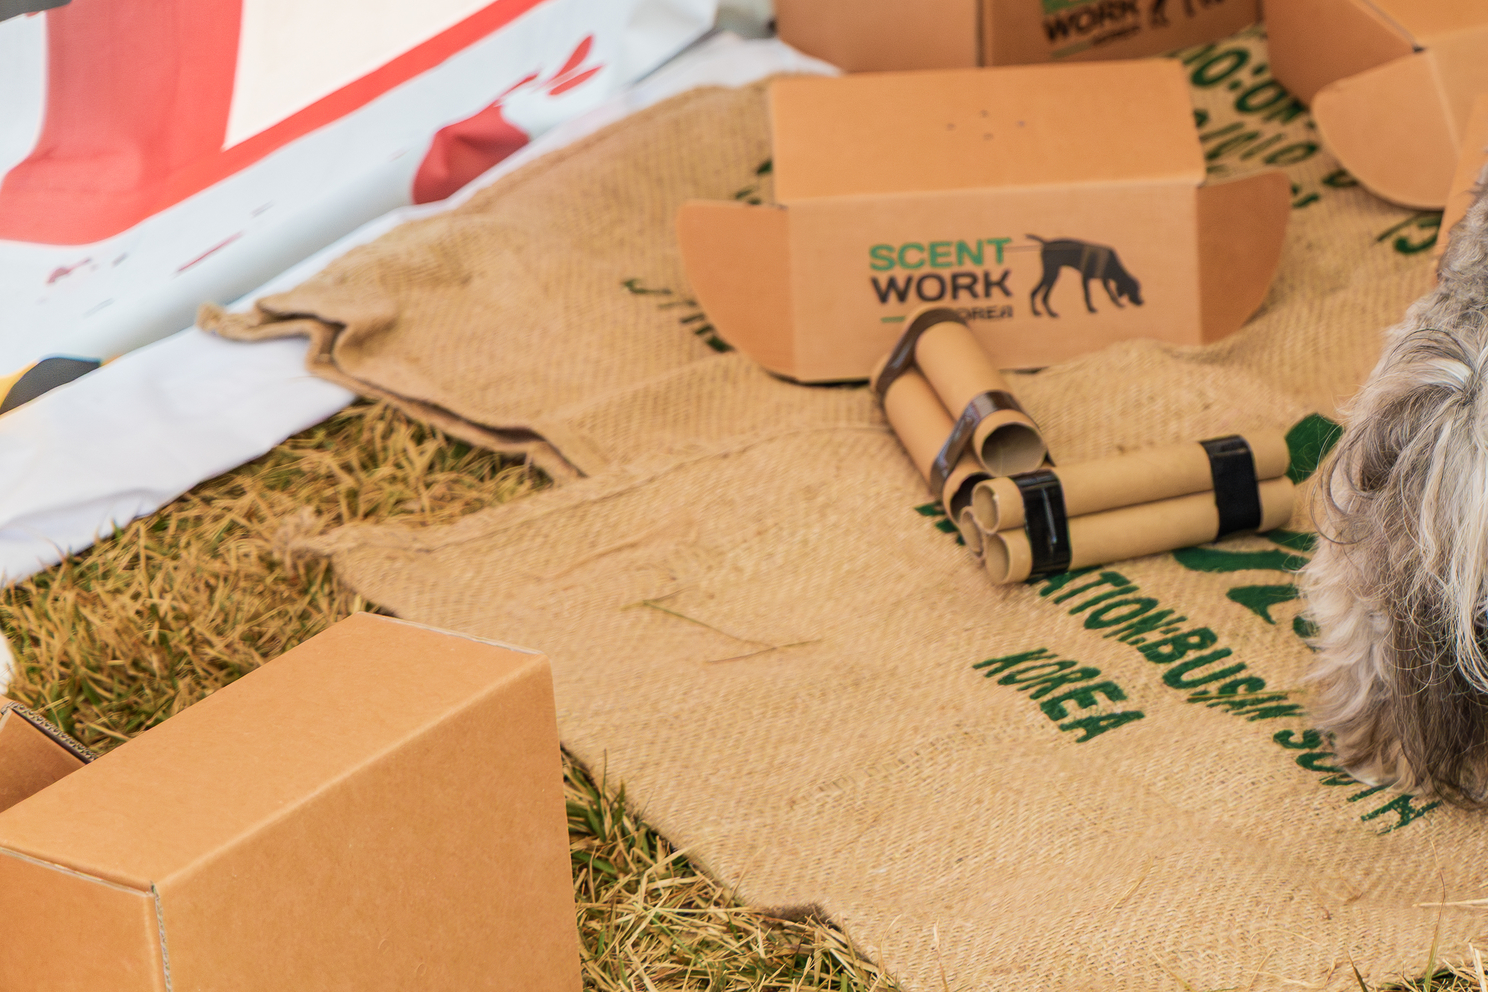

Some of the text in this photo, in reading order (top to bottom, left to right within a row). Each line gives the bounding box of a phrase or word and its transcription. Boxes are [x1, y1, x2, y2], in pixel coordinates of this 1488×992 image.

[868, 237, 1012, 271] SCENT
[870, 269, 1013, 304] WORK
[950, 304, 1014, 321] OREA
[972, 648, 1146, 743] KOREA
